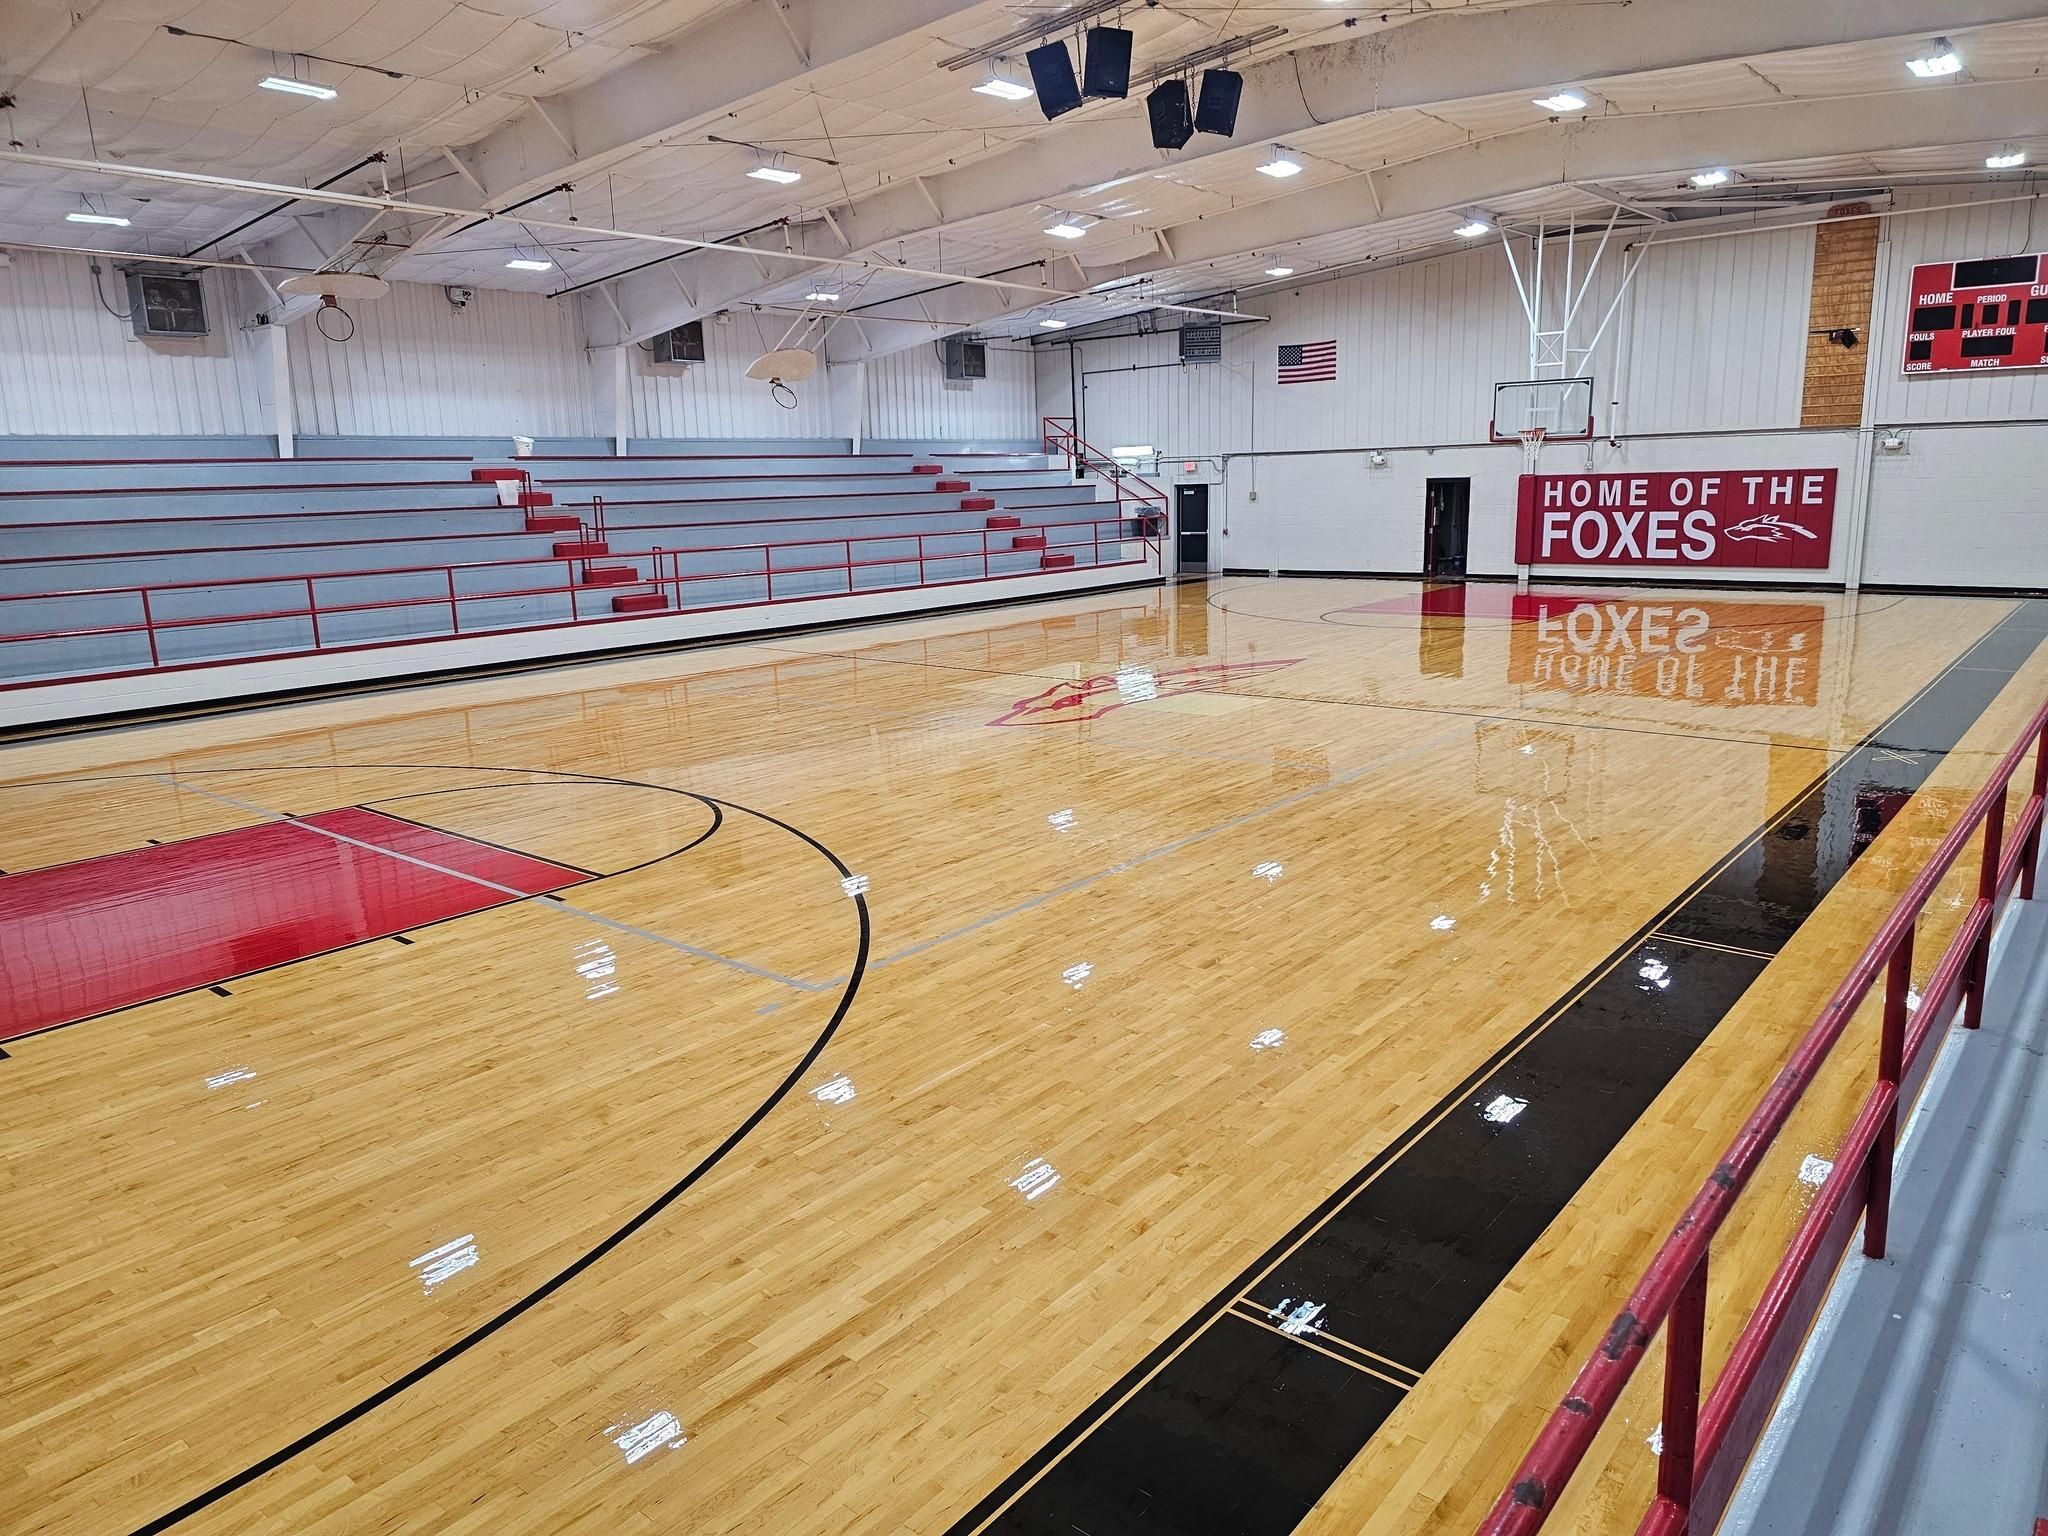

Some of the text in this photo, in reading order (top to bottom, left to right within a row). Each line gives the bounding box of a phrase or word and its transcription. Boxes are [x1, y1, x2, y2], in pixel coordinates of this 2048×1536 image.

[1919, 292, 1953, 305] HOME
[1977, 294, 2007, 304] PERIOD
[1910, 332, 1935, 341] FOULS
[1962, 327, 2017, 338] PLAYER FOUL
[1906, 363, 1931, 371] SCORE
[1971, 358, 2000, 367] MATCH
[1544, 475, 1824, 507] HOME OF THE
[1541, 510, 1716, 561] FOXES
